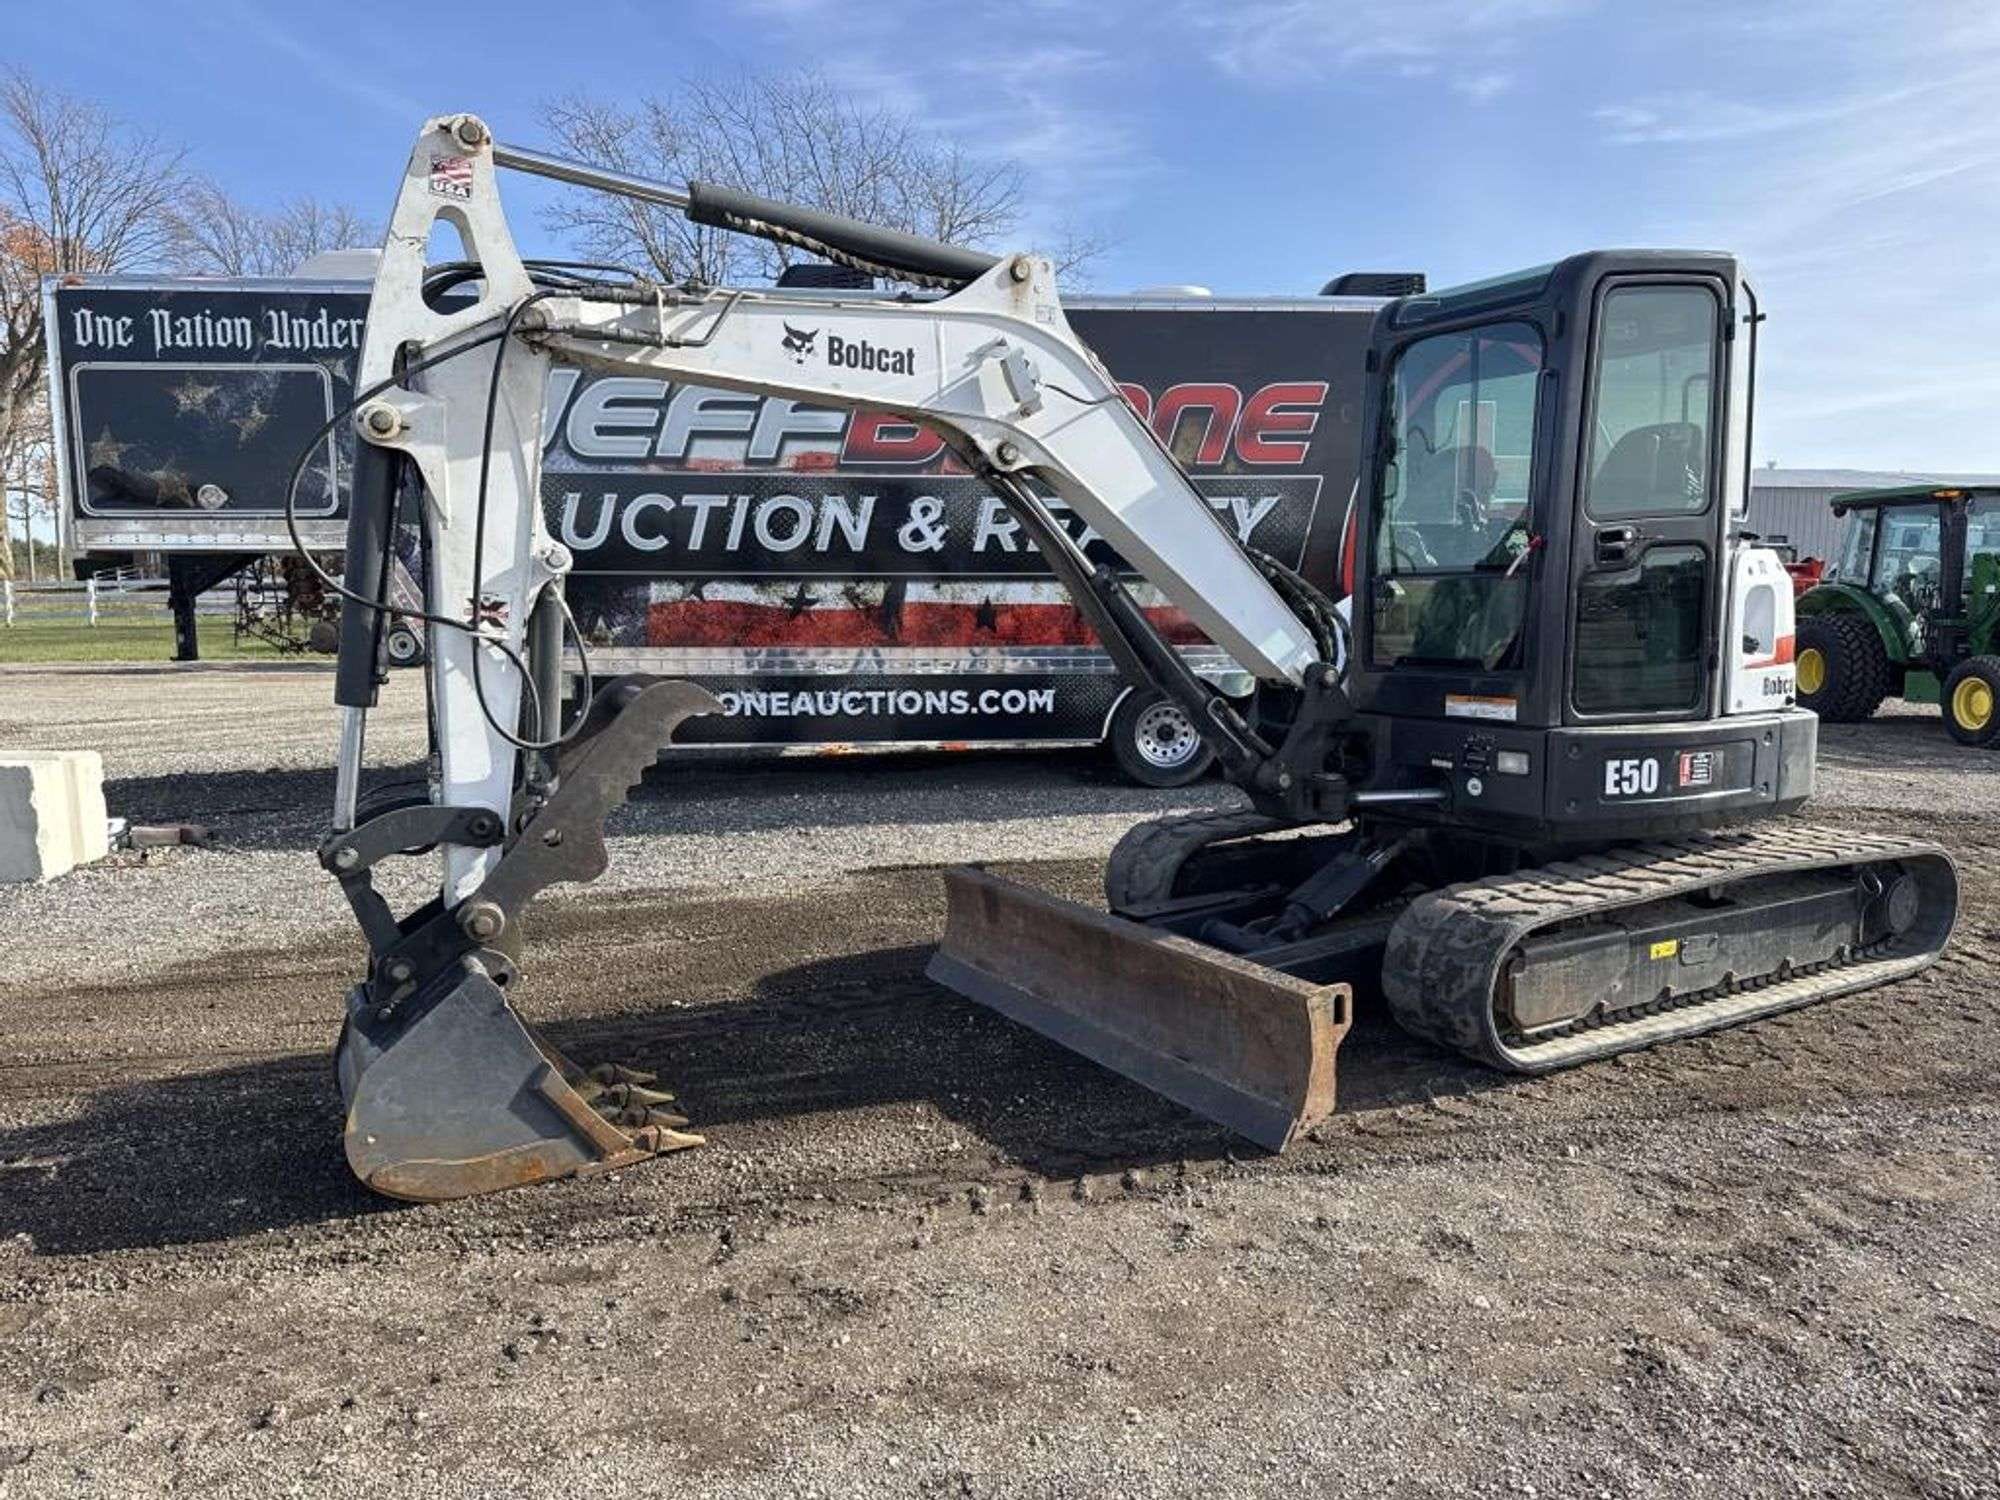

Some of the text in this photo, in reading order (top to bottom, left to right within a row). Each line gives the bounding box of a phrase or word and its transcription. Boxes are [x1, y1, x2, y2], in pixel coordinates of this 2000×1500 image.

[71, 307, 364, 358] One Nation Under
[828, 336, 915, 376] Bobcat
[560, 493, 880, 553] UCTION
[898, 496, 949, 553] &
[694, 688, 1056, 717] ONEAUCTIONS.COM
[1605, 757, 1659, 796] E50
